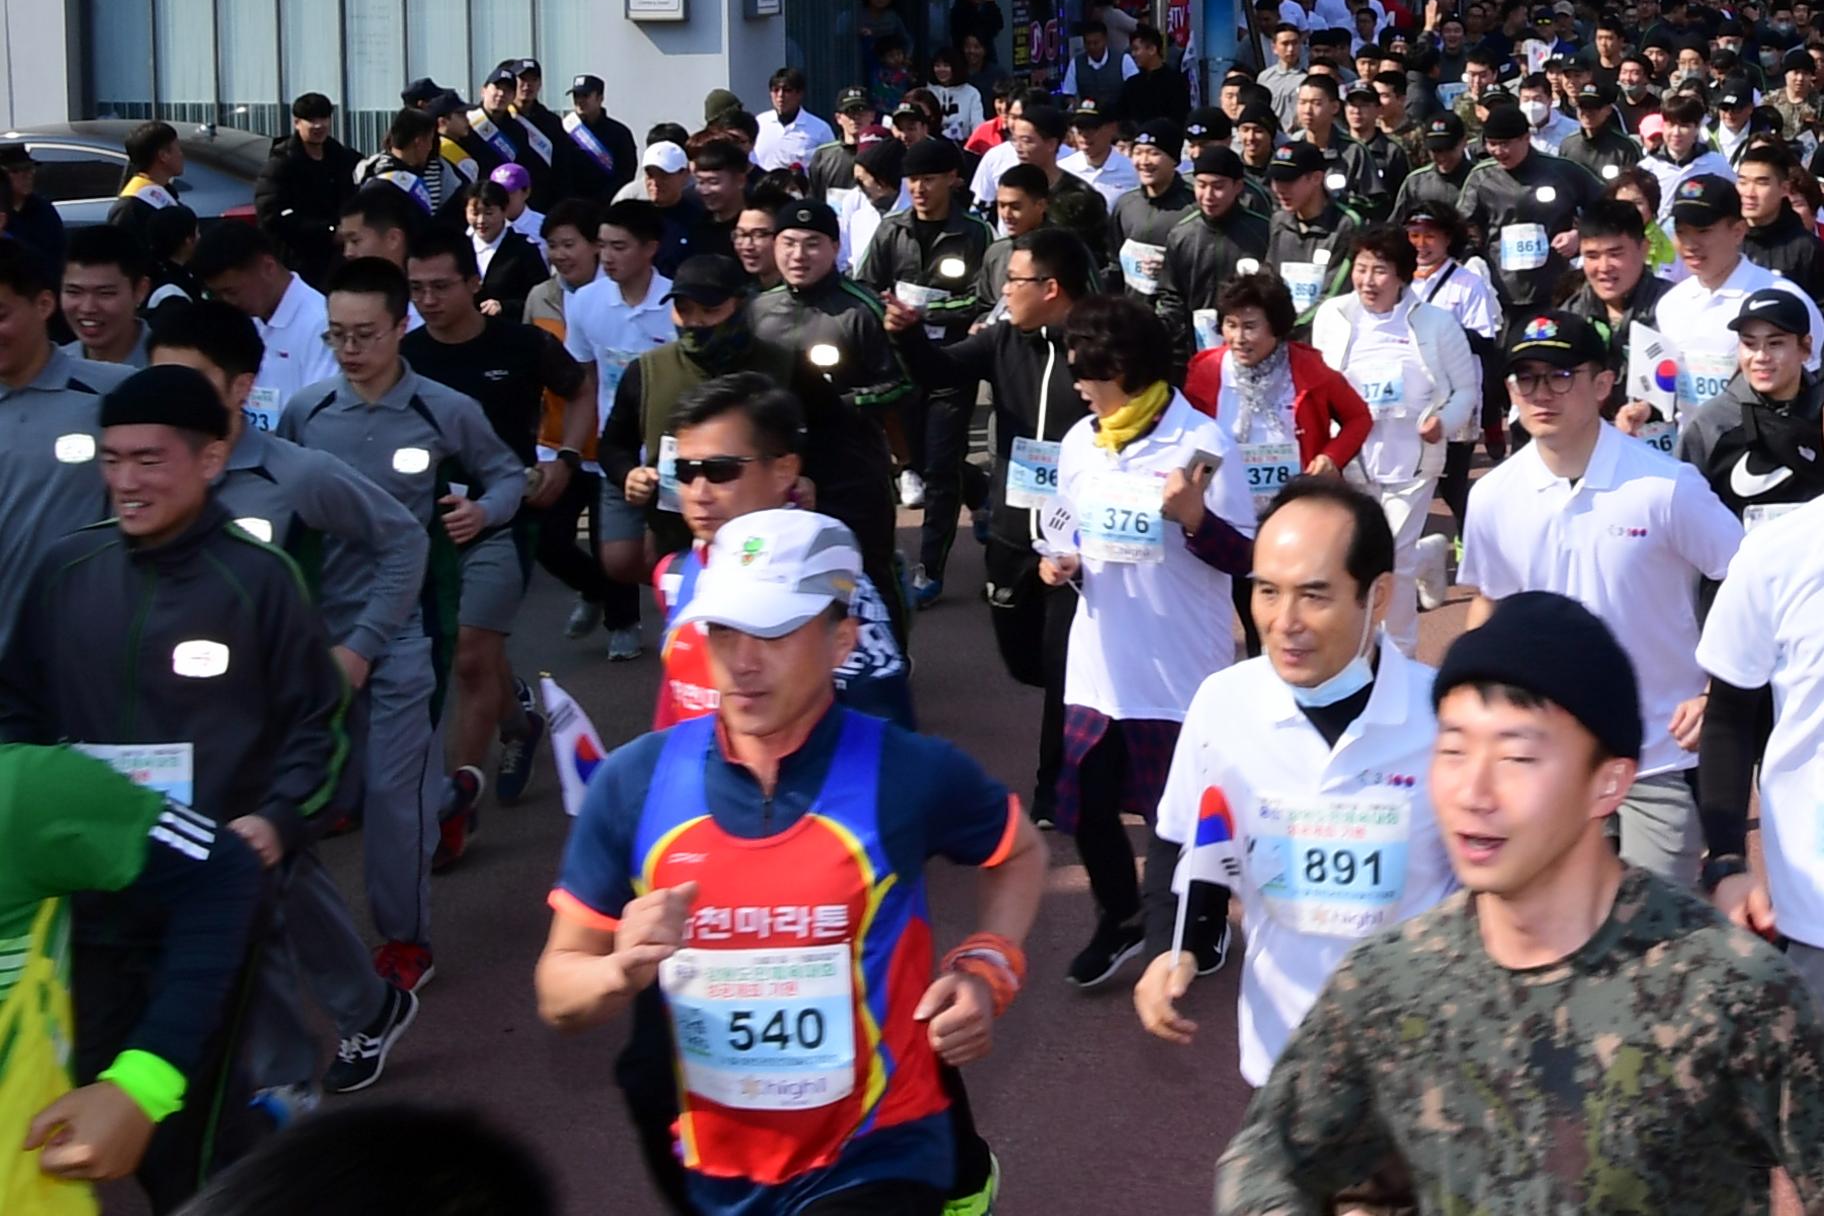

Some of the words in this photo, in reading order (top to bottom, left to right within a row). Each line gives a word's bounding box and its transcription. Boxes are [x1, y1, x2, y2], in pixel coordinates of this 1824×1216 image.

[1516, 240, 1543, 253] 861
[1248, 465, 1290, 486] 378
[1103, 507, 1150, 534] 376
[1304, 847, 1382, 886] 891
[728, 1007, 824, 1052] 540
